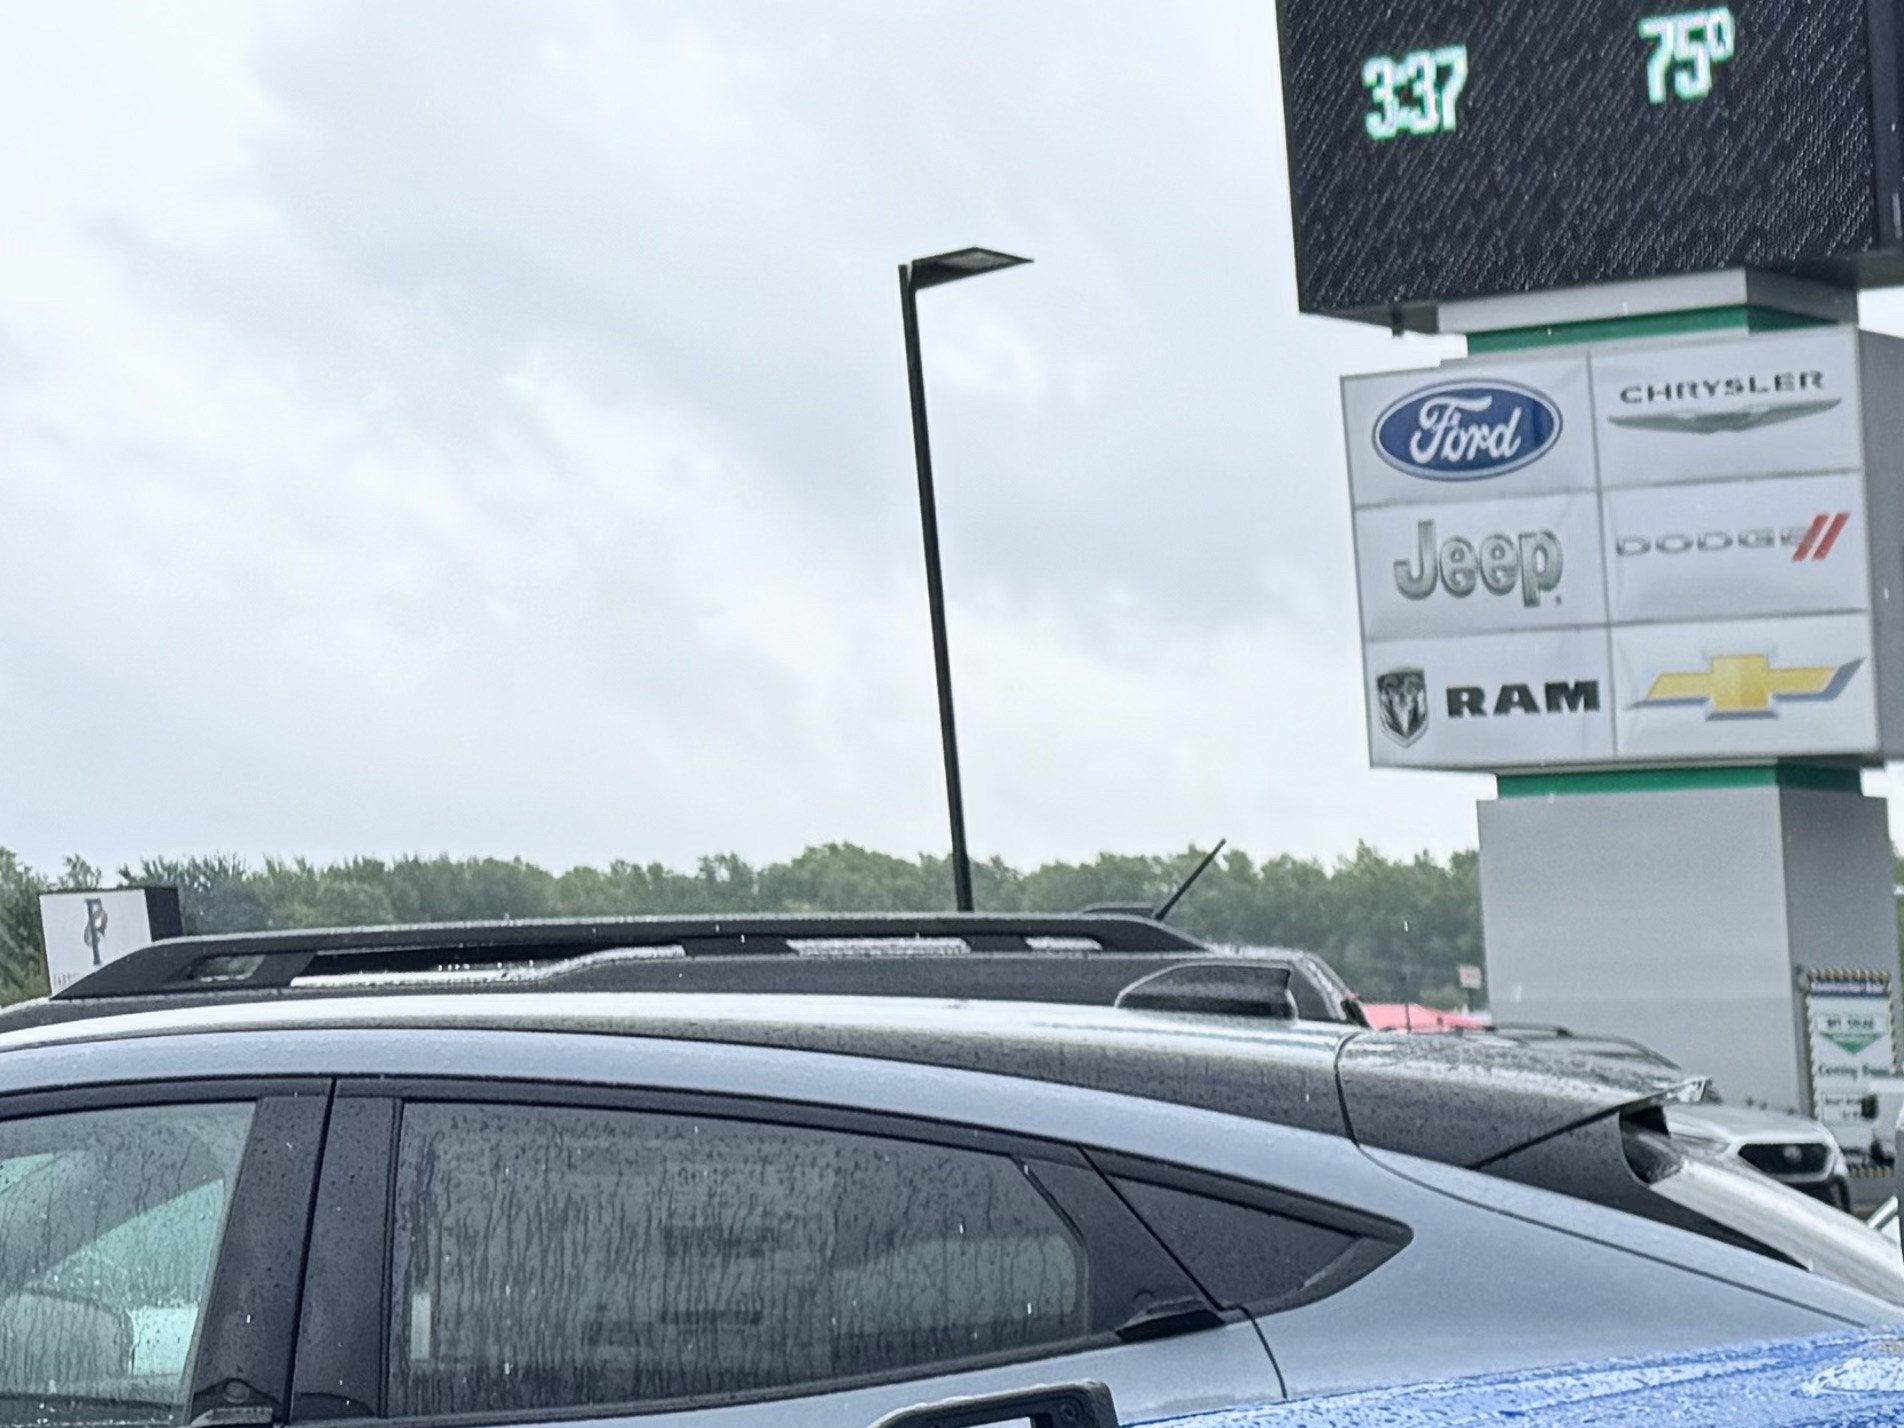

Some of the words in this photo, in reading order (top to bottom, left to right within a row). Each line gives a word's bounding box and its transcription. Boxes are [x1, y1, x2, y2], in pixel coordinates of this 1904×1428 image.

[1620, 370, 1824, 403] CHRYSLER
[1409, 395, 1522, 465] Ford
[1393, 518, 1564, 608] Jeep
[1446, 679, 1601, 719] RAM
